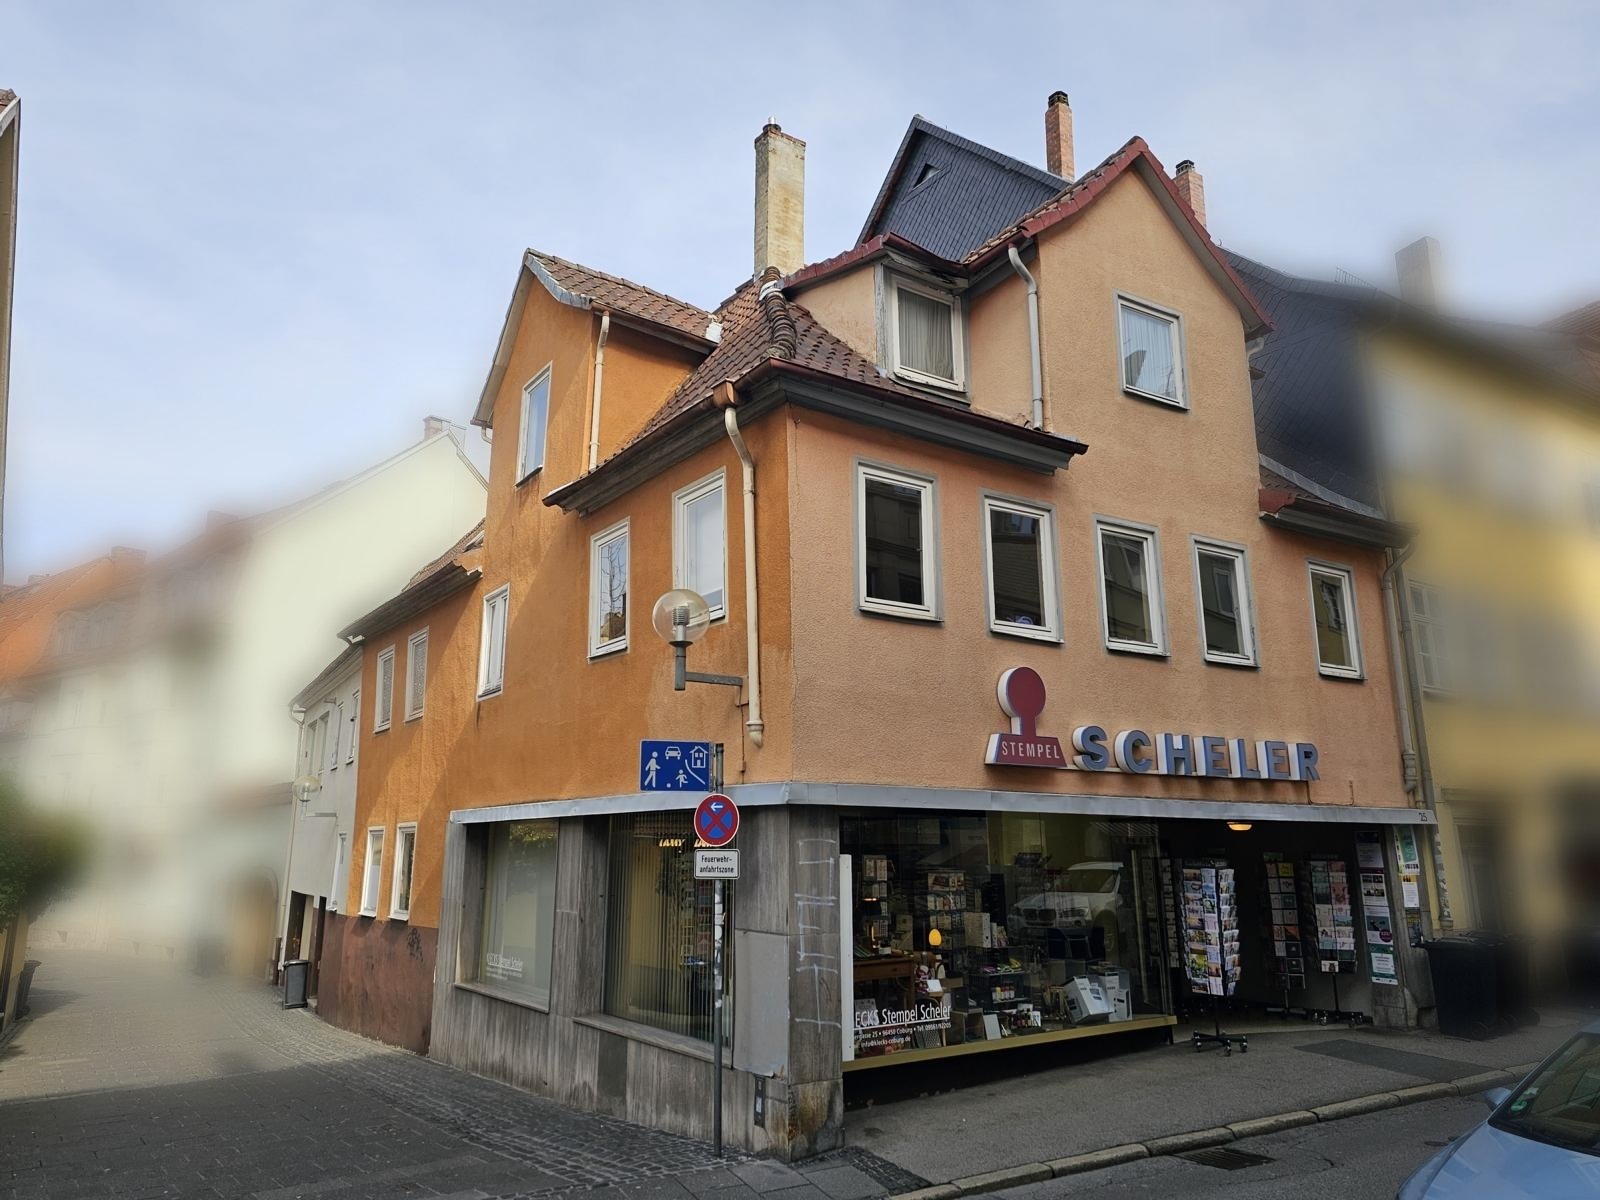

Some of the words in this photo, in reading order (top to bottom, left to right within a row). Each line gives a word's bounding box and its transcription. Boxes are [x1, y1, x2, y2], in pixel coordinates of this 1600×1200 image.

[1002, 741, 1060, 759] STEMPEL
[1072, 725, 1320, 781] SCHELER
[701, 854, 733, 863] Feuerwehr-
[699, 865, 735, 874] anfahrtszone
[882, 1004, 918, 1026] Stempel
[920, 1002, 951, 1020] Scheler
[897, 1027, 913, 1035] Coburg
